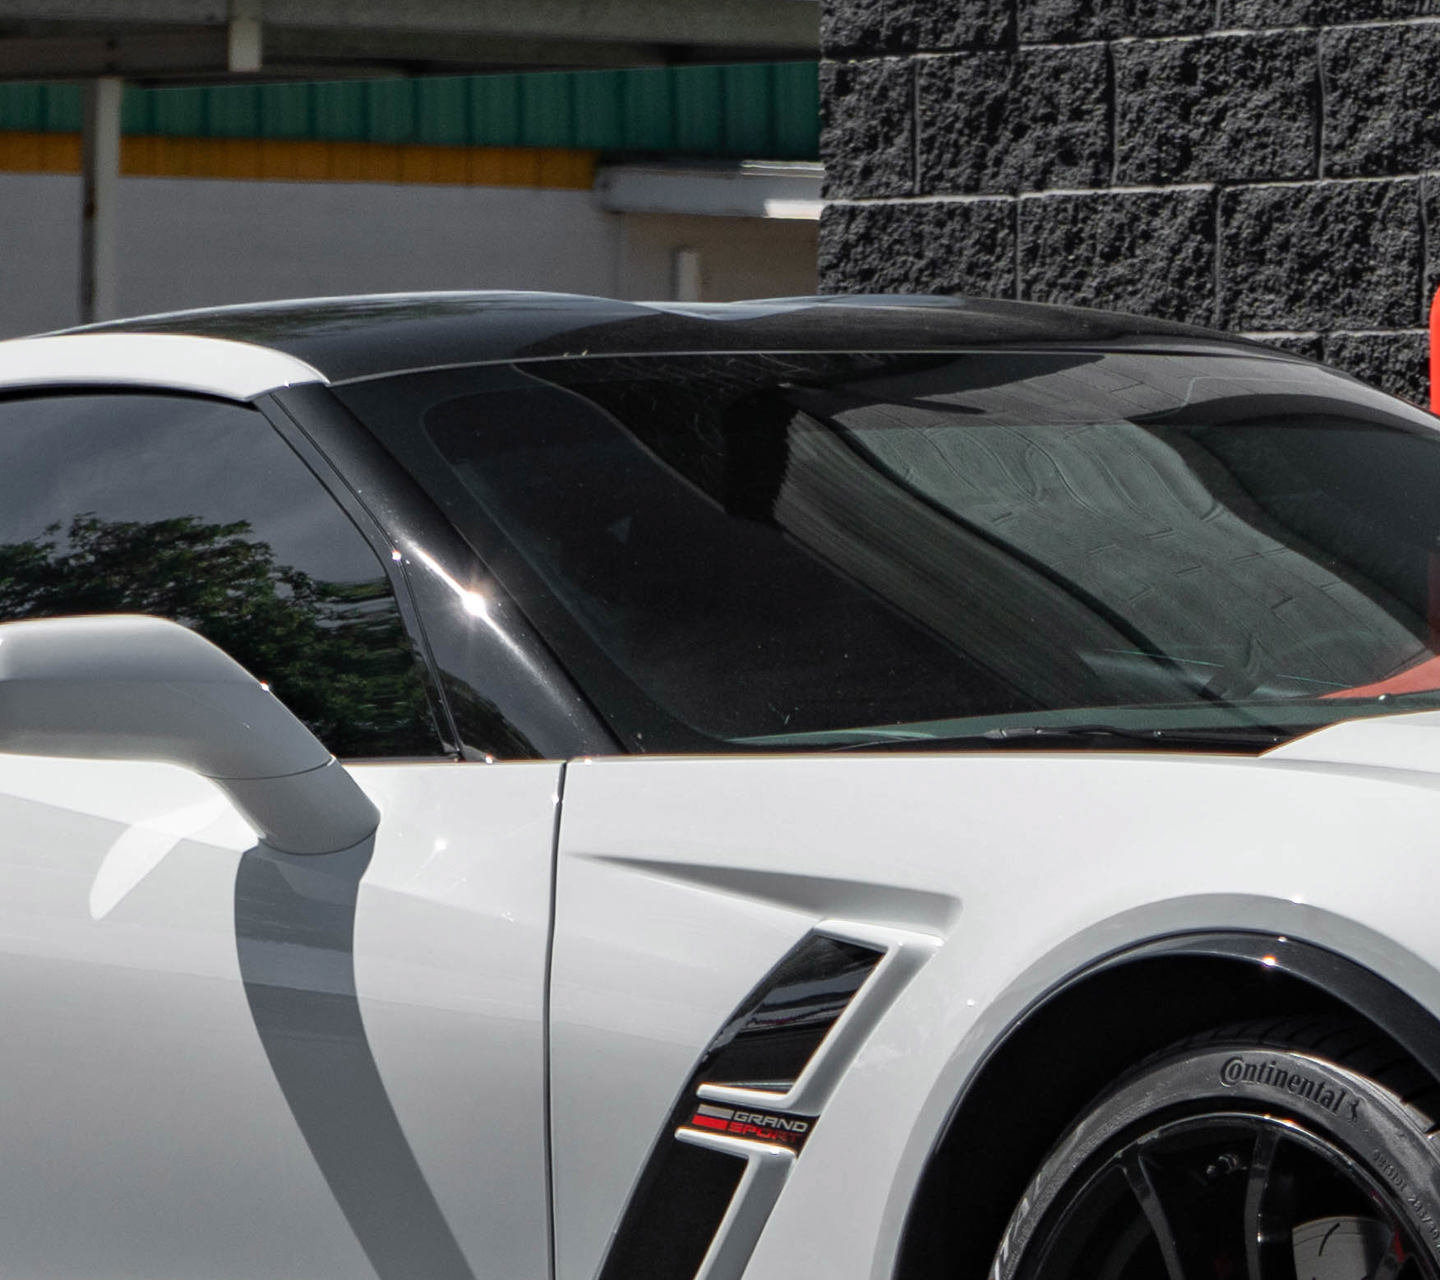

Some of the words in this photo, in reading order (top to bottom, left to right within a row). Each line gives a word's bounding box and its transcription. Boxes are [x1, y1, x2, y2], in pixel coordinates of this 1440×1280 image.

[1220, 1055, 1347, 1114] Continental
[729, 1122, 803, 1142] SPORT
[734, 1112, 808, 1132] GRAND
